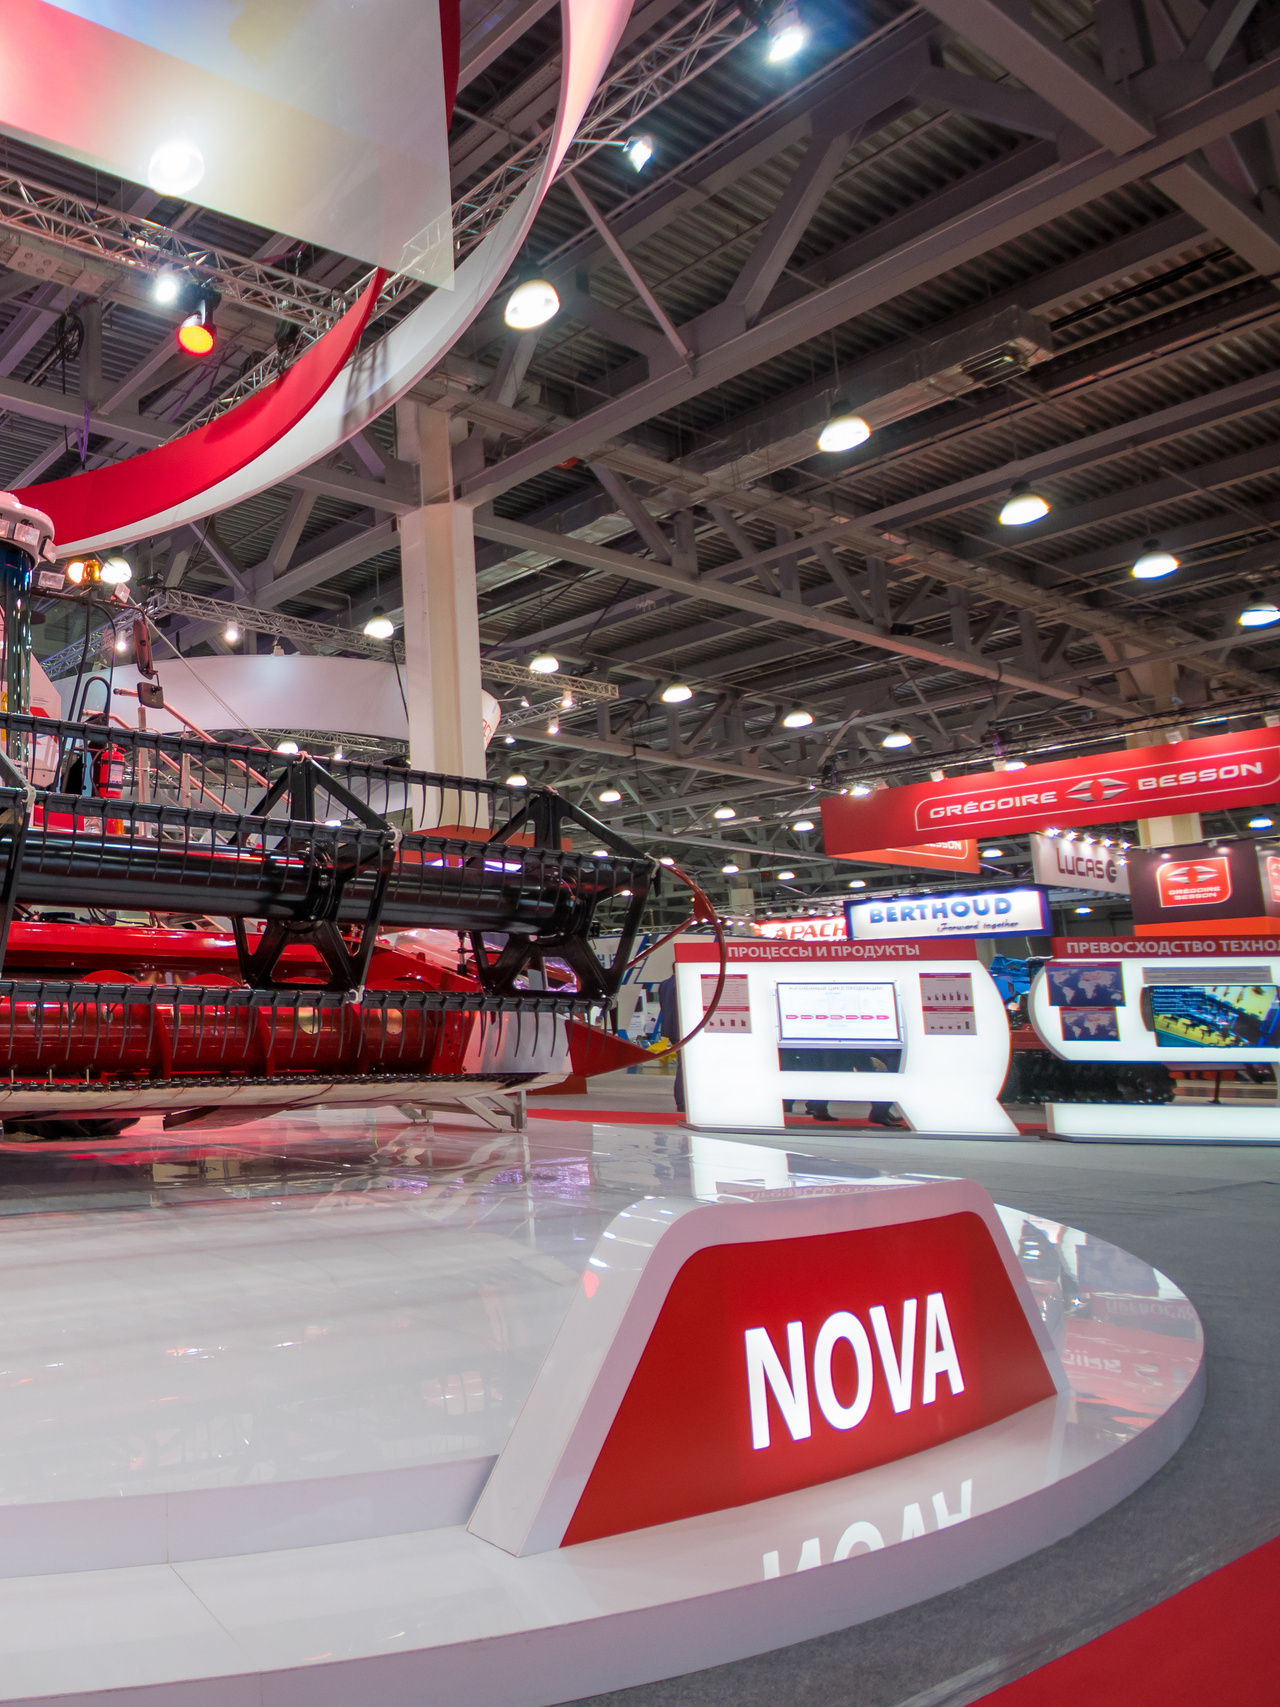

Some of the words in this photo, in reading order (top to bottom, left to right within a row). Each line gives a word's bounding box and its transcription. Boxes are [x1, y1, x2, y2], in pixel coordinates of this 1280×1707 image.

[929, 790, 1058, 820] GRÉGOIRE
[1138, 761, 1263, 791] BESSON
[1056, 847, 1105, 879] LUCAS
[1174, 892, 1218, 901] BESSON
[869, 897, 1012, 924] BERTHOUD
[728, 946, 813, 960] ПРОЦЕССЫ
[816, 946, 828, 957] И
[830, 944, 920, 959] ПРОДУКТЫ
[1066, 940, 1217, 955] ПРЕВОСХОДСТВО
[1219, 939, 1280, 952] ТЕХНО
[745, 1291, 965, 1450] NOVA
